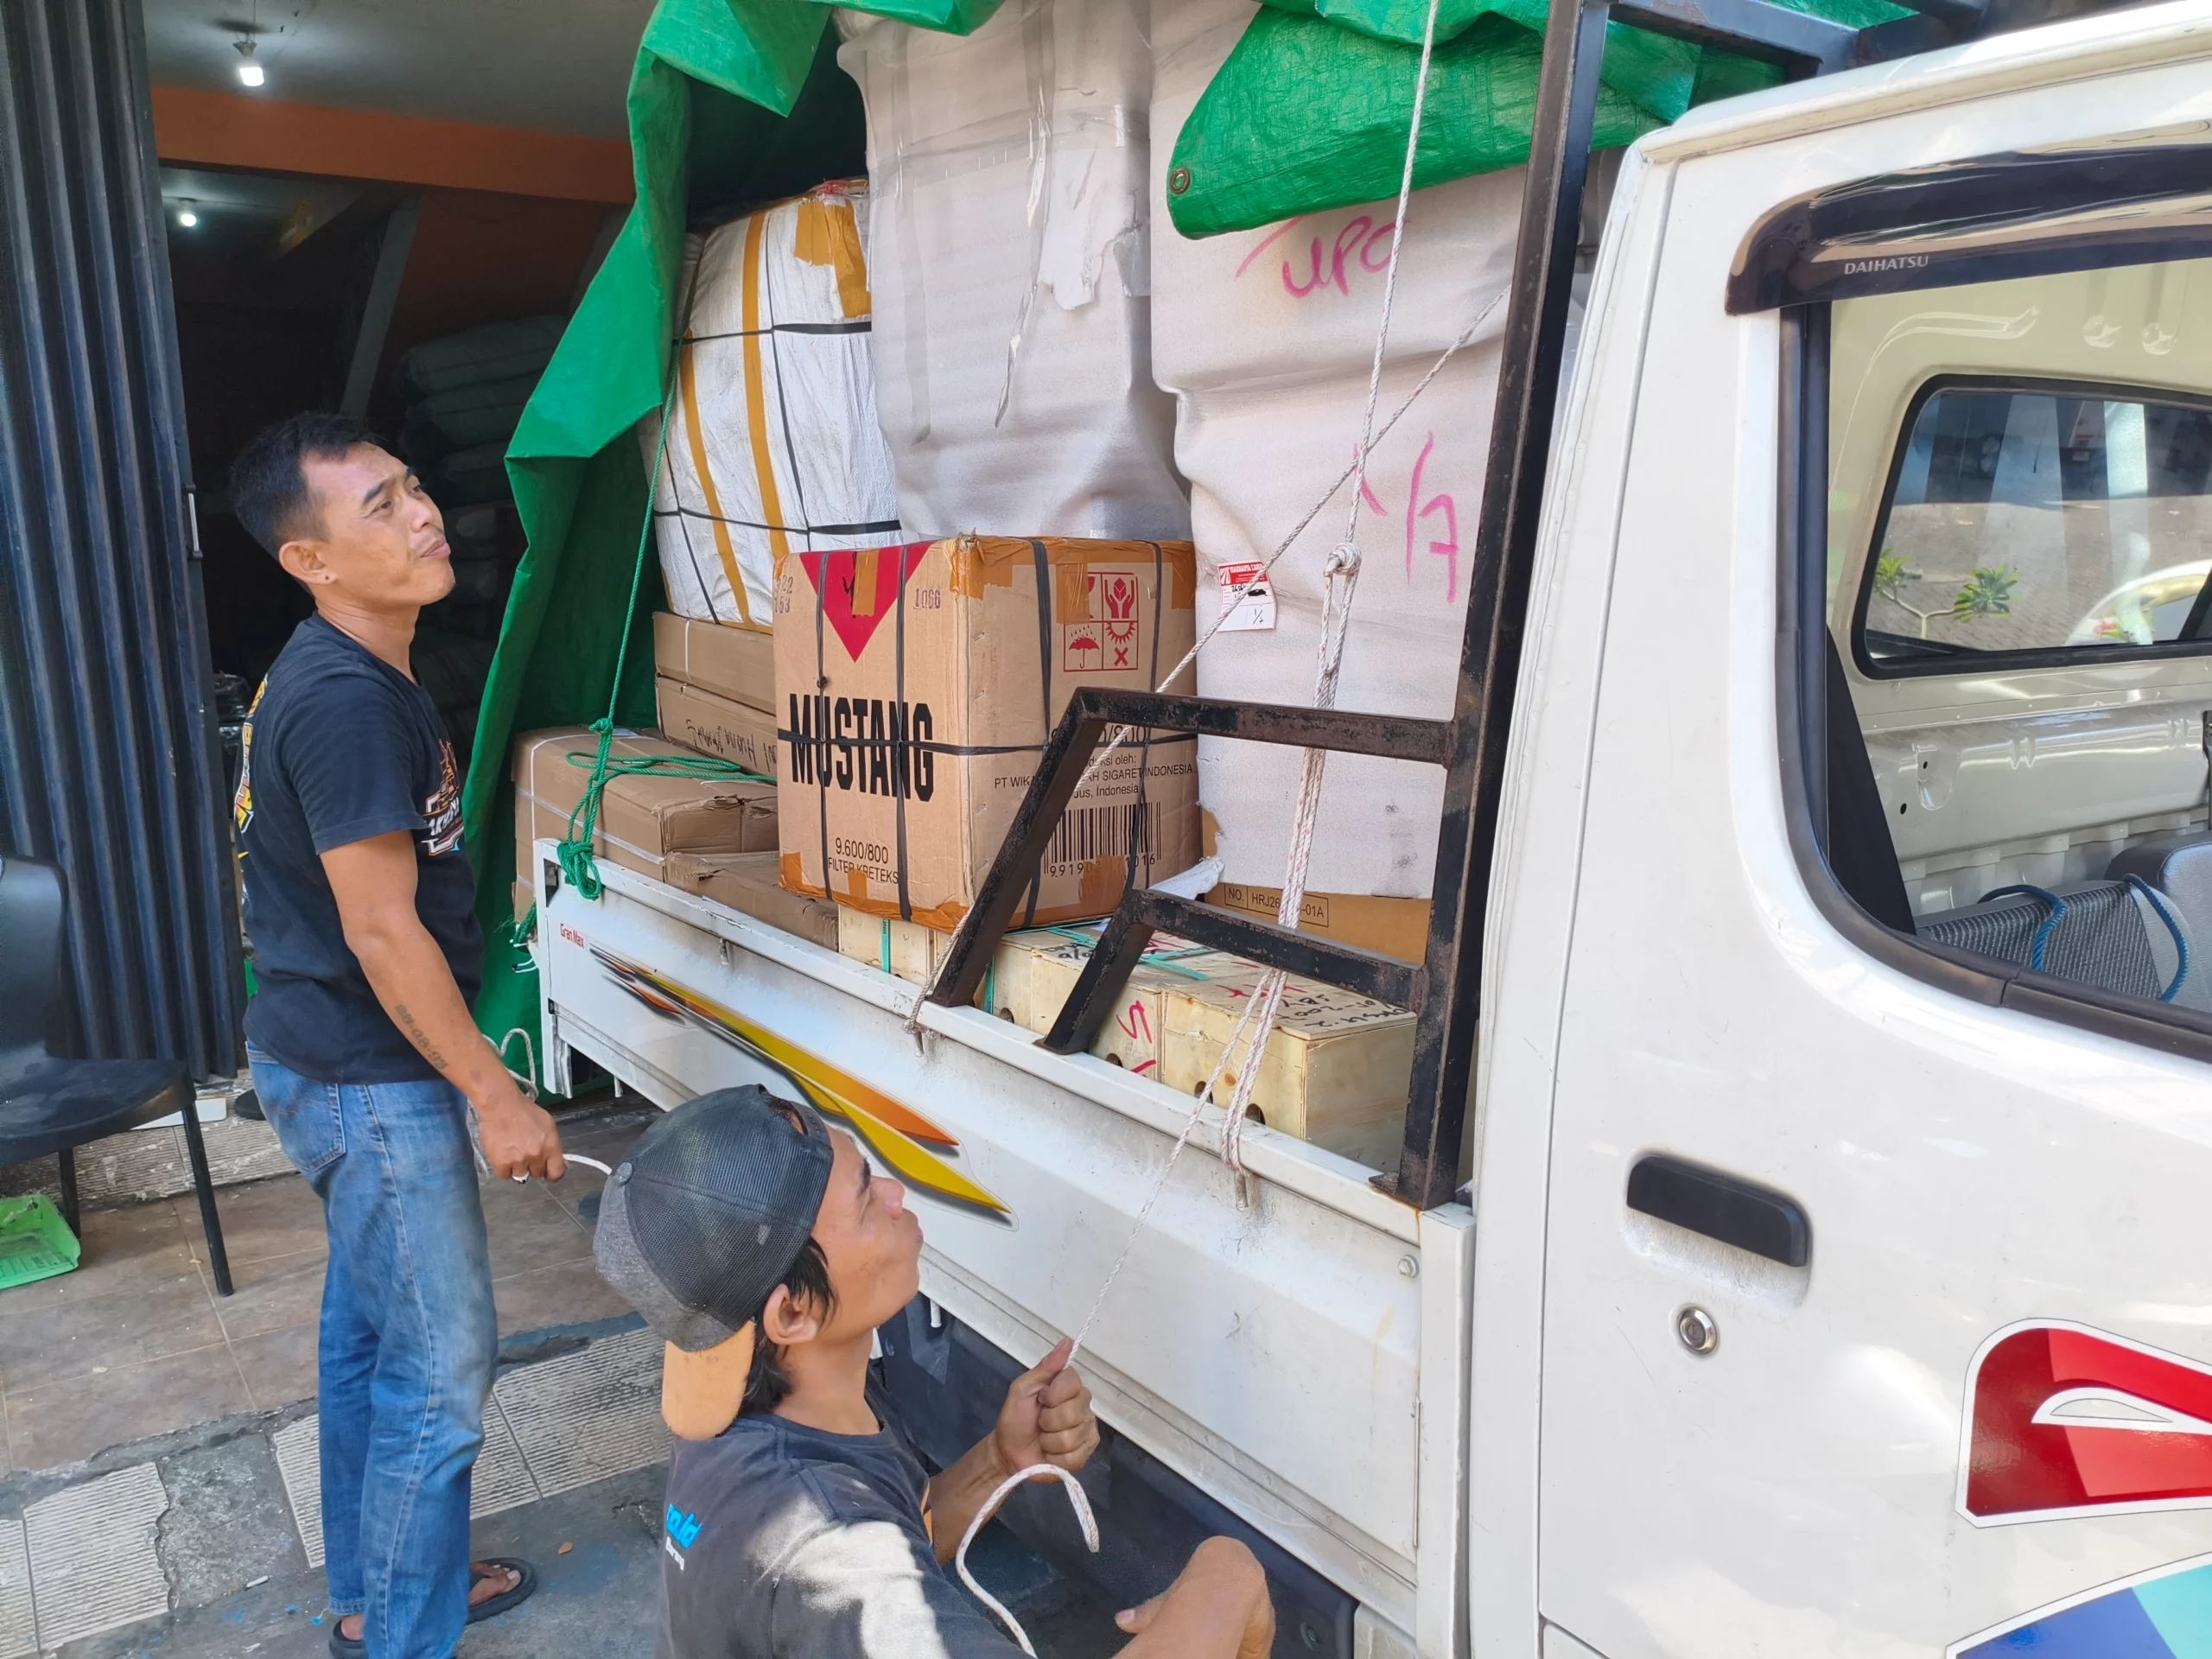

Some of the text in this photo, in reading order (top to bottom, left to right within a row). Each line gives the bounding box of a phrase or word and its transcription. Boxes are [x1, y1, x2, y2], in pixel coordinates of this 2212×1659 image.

[1844, 255, 1929, 275] DAIHATSU
[790, 693, 934, 802] MUSTANG
[1115, 753, 1137, 766] oleh:
[994, 777, 1007, 790] PT
[1102, 767, 1141, 782] SIGARET
[1145, 763, 1194, 779] INDONESIA
[1096, 785, 1140, 798] Indonesia
[835, 837, 889, 865] 9.600/800
[828, 855, 899, 885] FILTER KRETEKS
[1228, 887, 1244, 901] NO.
